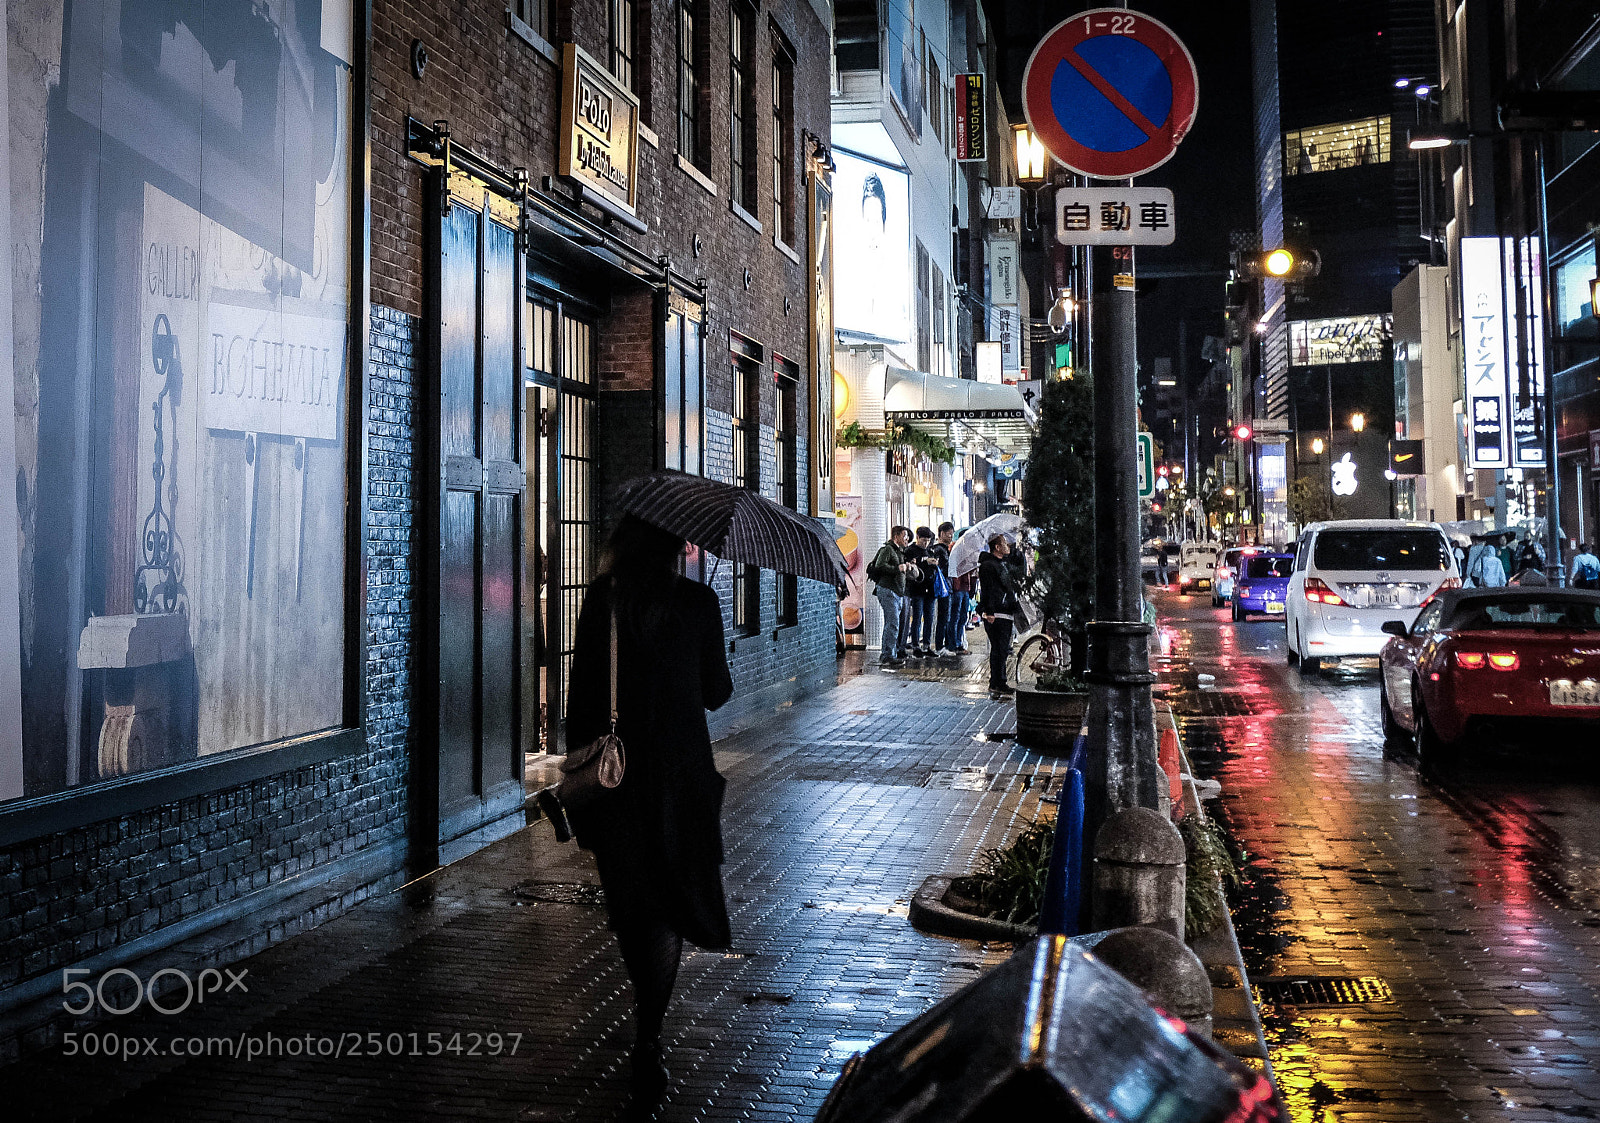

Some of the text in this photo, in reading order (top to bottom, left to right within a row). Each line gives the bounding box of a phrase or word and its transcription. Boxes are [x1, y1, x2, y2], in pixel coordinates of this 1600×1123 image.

[1083, 15, 1135, 34] 1-22
[580, 81, 609, 133] Polo
[1063, 201, 1169, 231] 自動車
